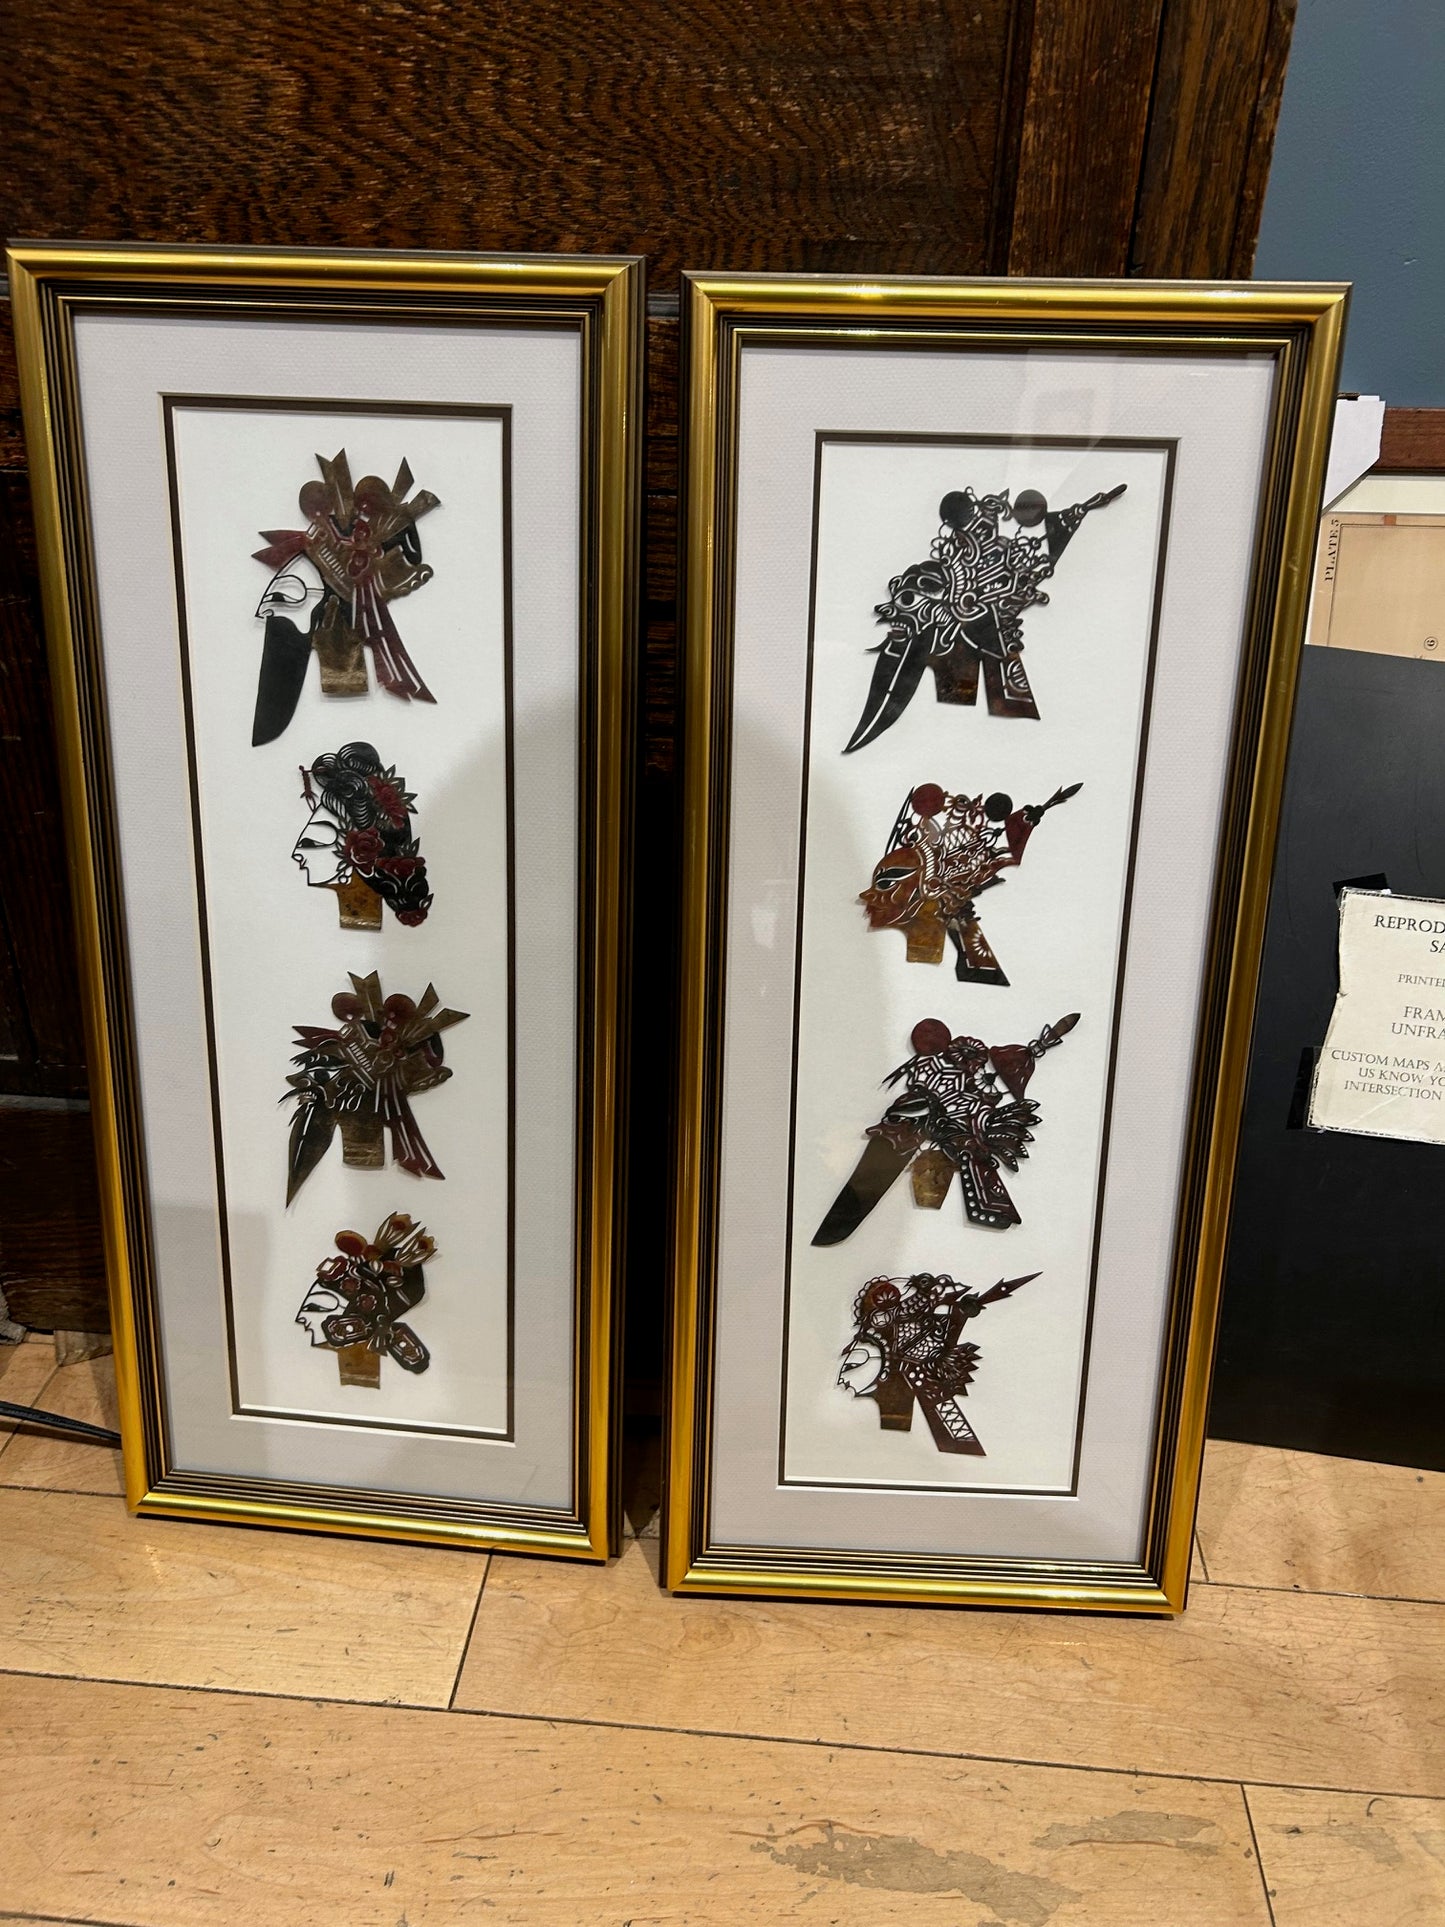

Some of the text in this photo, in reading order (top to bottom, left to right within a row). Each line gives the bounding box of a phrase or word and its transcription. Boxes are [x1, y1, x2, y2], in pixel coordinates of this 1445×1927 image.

[1325, 519, 1340, 581] PLATE 5
[1374, 914, 1445, 934] REPROD
[1391, 1022, 1445, 1040] UNFRA
[1331, 1049, 1445, 1073] CUSTOM MAPS A
[1358, 1067, 1375, 1079] US
[1378, 1069, 1425, 1084] KNOW
[1343, 1080, 1442, 1101] INTERSECTION
